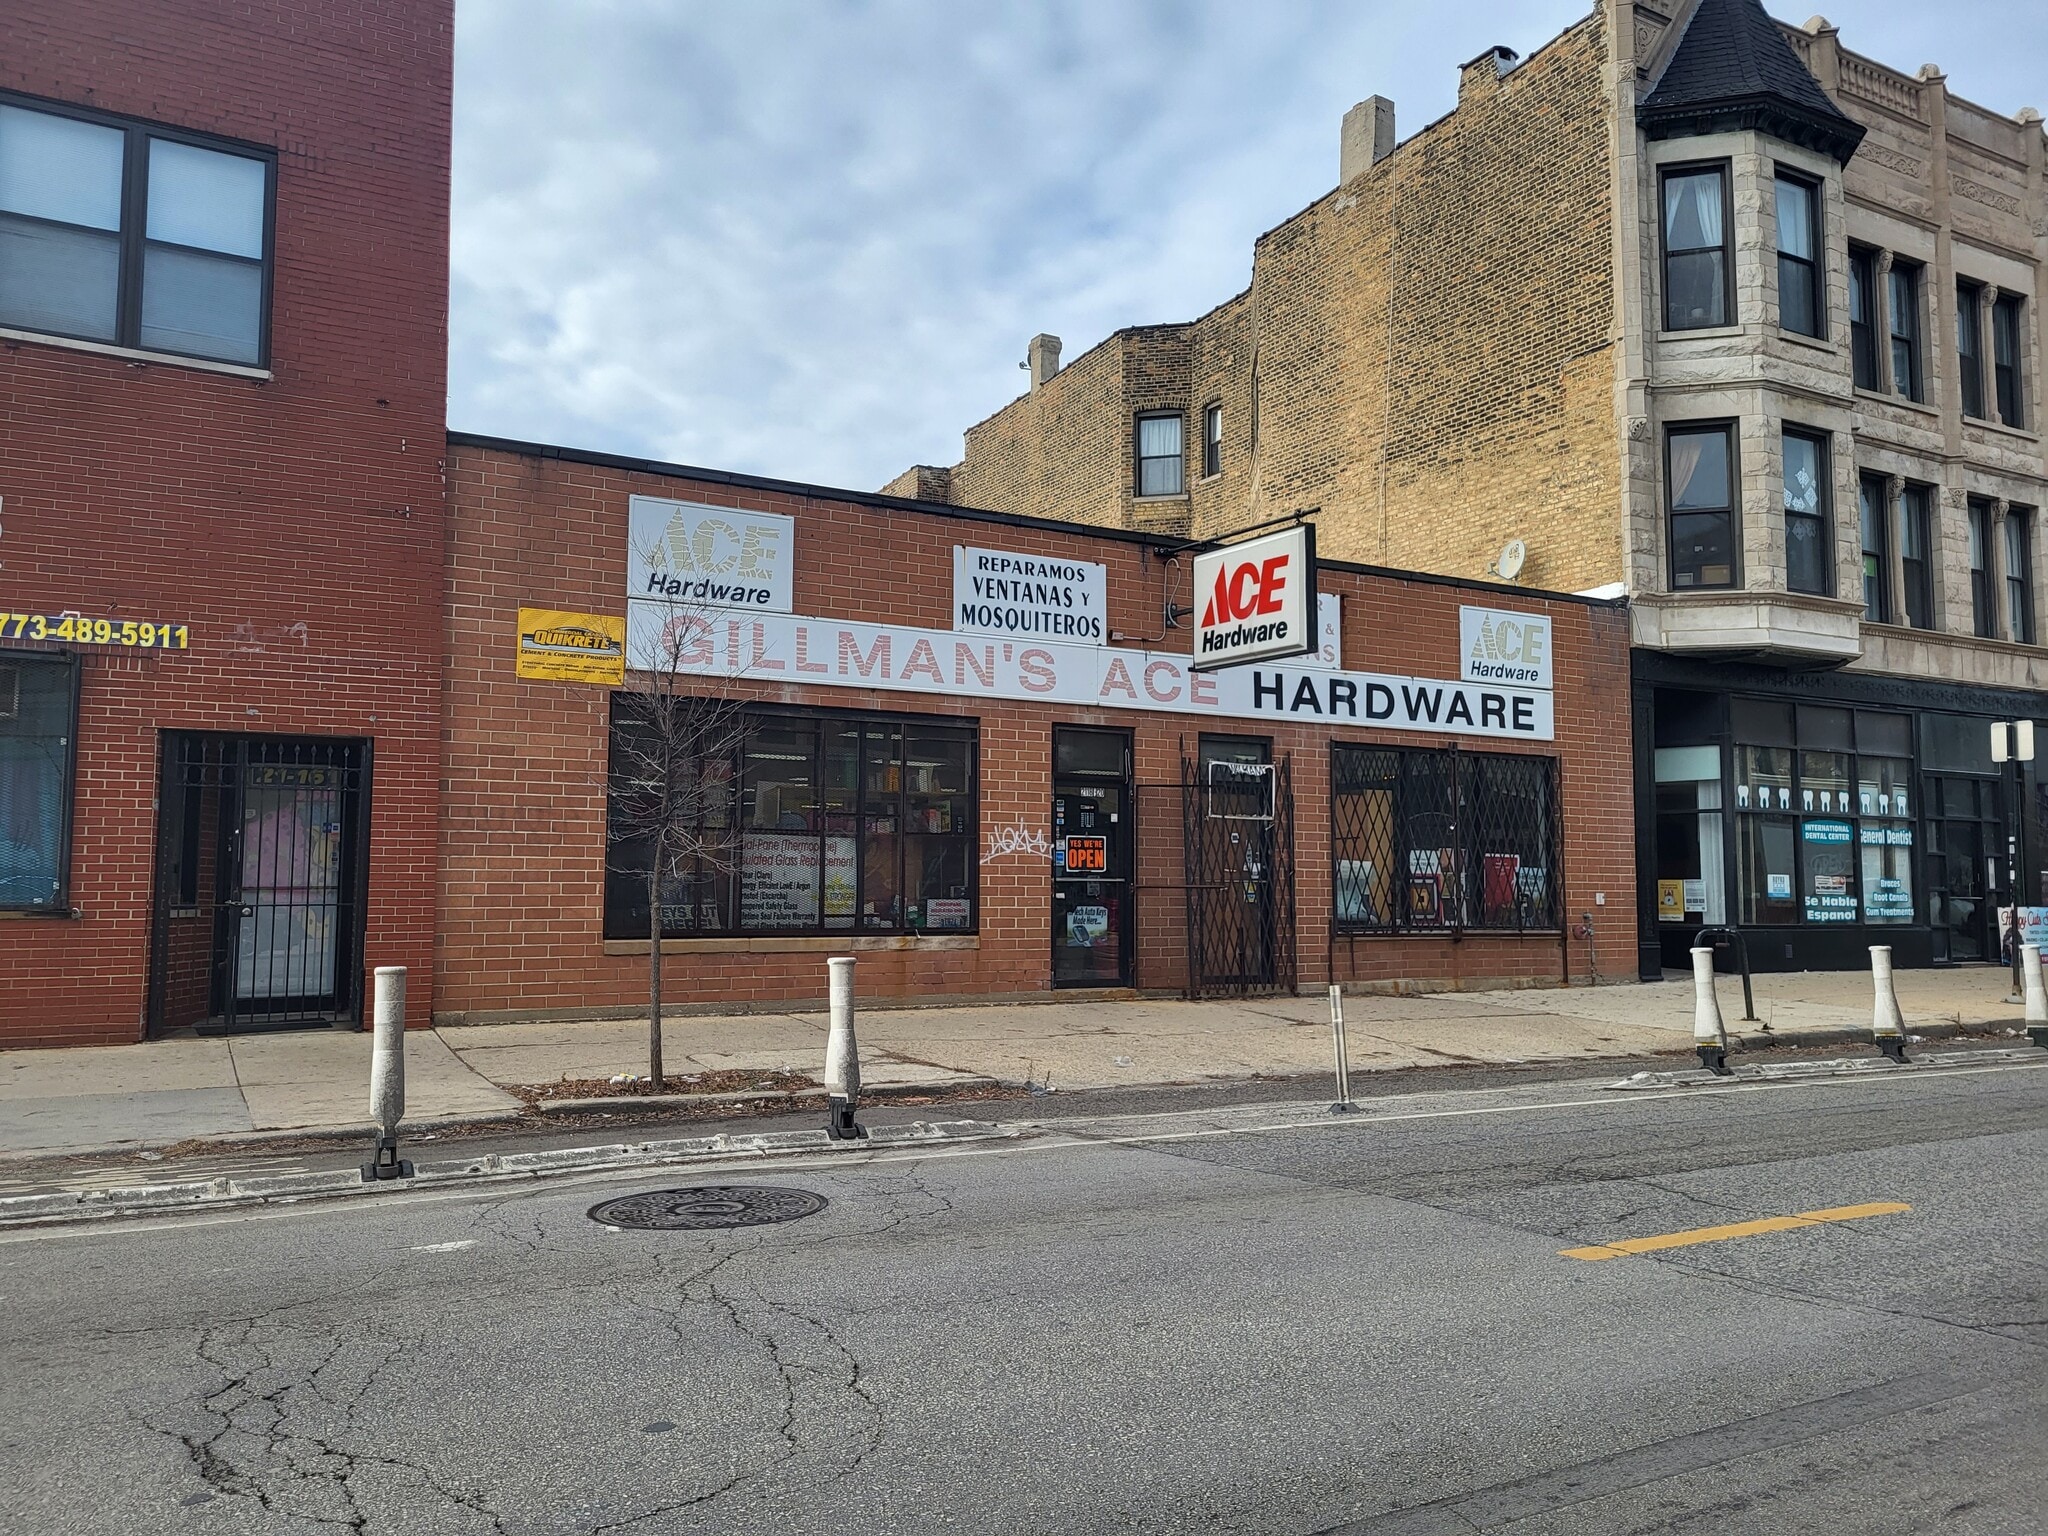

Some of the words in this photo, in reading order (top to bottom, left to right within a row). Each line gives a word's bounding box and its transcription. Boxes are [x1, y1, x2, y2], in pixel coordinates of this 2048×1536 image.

[644, 506, 781, 580] ACE
[978, 555, 1085, 583] REPARAMOS
[647, 573, 771, 605] Hardware
[973, 576, 1073, 608] VENTANAS
[1081, 592, 1091, 606] Y
[1201, 553, 1290, 628] ACE
[961, 603, 1101, 638] MOSQUITEROS
[0, 613, 188, 649] 773-489-5911
[1202, 619, 1288, 654] Hardware
[1470, 612, 1544, 664] ACE
[534, 629, 611, 650] QUIKRETE
[553, 651, 584, 659] CONCRETE
[661, 614, 1057, 693] GILLMAN'S
[1099, 657, 1219, 706] ACE
[1253, 670, 1535, 732] HARDWARE
[1470, 660, 1539, 682] Hardware
[1804, 823, 1850, 833] INTERNATIONAL
[1070, 840, 1082, 848] YES
[1083, 840, 1103, 848] WE'RE
[1805, 832, 1828, 840] DENTAL
[1828, 832, 1850, 841] CENTER
[1886, 829, 1913, 845] Dentist
[742, 854, 774, 867] sulated
[1068, 848, 1104, 868] OPEN
[1880, 879, 1901, 888] Braces
[1804, 895, 1819, 907] Se
[1821, 896, 1858, 907] Habla
[1873, 892, 1888, 902] Root
[1888, 893, 1909, 902] Canals
[661, 906, 686, 918] EYS
[1084, 907, 1096, 916] Auto
[1096, 908, 1107, 918] Keys
[1806, 910, 1857, 921] Espanol
[1865, 907, 1880, 917] Gum
[1880, 907, 1915, 917] Treatments
[1073, 916, 1086, 925] Made
